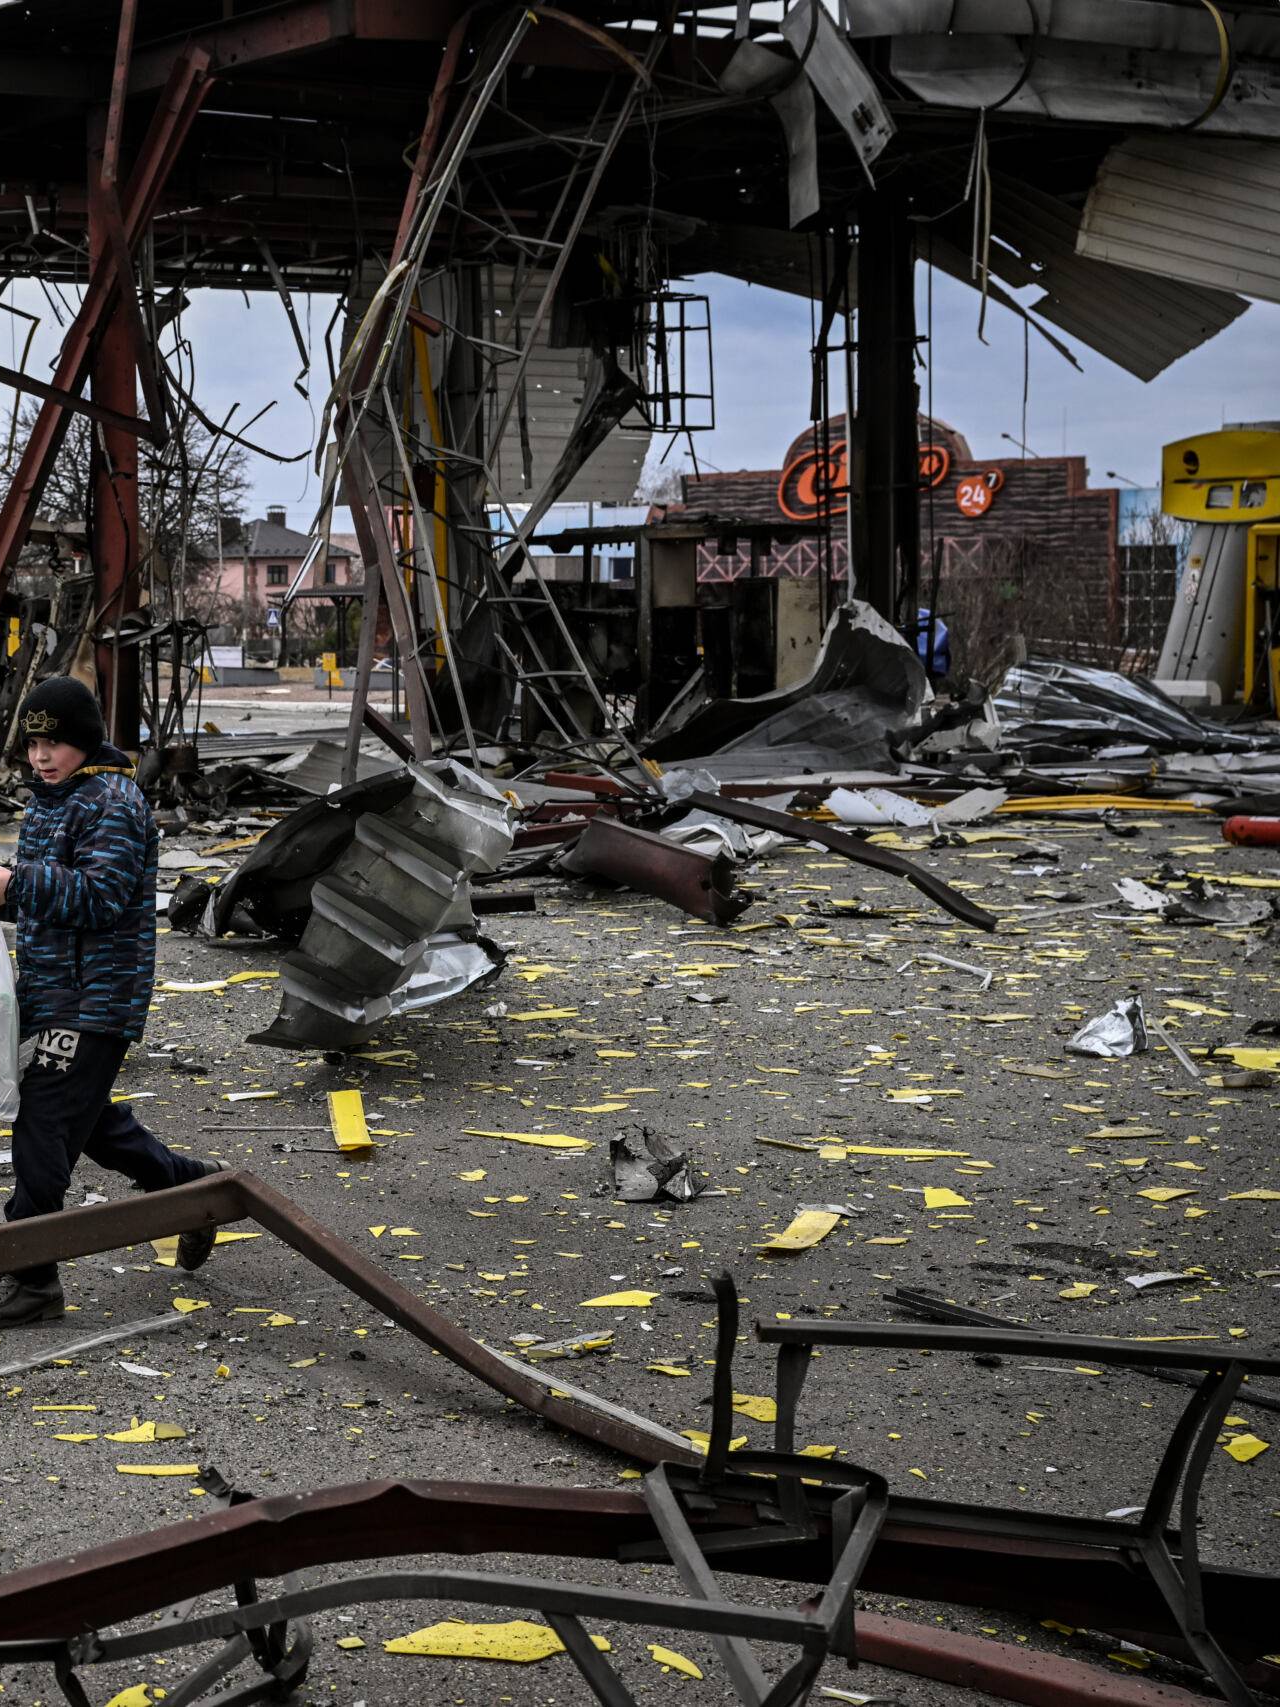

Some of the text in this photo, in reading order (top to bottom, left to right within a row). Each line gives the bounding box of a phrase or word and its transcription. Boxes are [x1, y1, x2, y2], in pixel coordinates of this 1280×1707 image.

[1183, 448, 1200, 475] 9
[960, 472, 997, 507] 24 7
